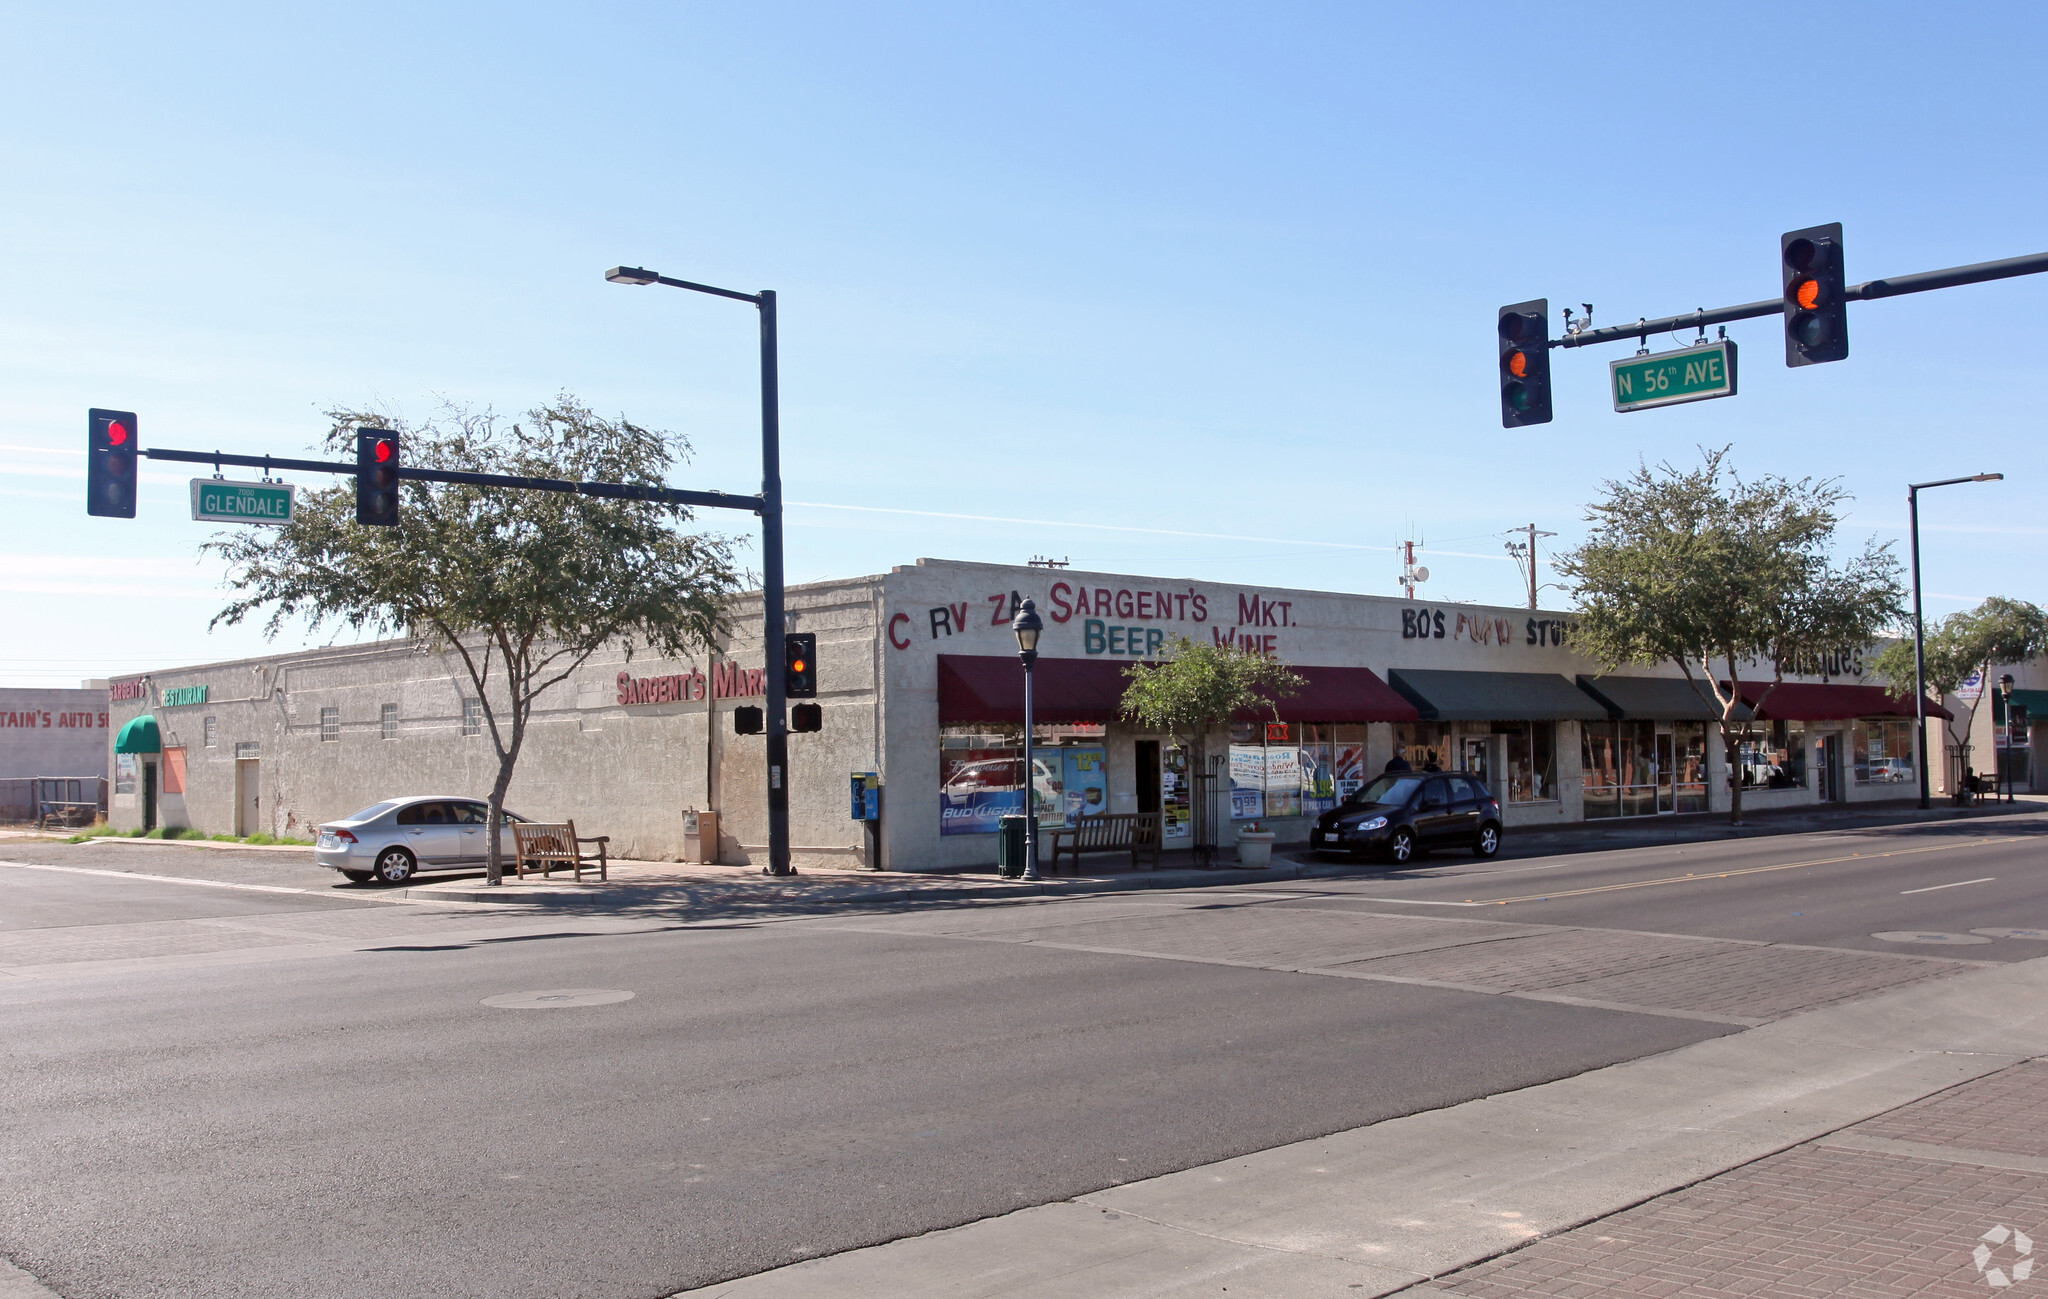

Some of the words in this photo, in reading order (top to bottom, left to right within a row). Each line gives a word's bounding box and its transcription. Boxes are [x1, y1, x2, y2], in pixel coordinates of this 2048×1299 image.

[1618, 373, 1632, 396] N
[1644, 366, 1677, 392] 56th
[1684, 357, 1722, 386] AVE
[238, 488, 255, 497] 7000
[205, 494, 285, 516] GLENDALE
[1050, 582, 1208, 623] SARGENT'S
[1238, 593, 1297, 627] MKT.
[1085, 619, 1164, 656] BEER
[161, 685, 208, 708] RESTAURANT
[616, 667, 707, 705] SARGENT'S
[0, 709, 52, 729] TAIN'S
[58, 712, 93, 729] AUTO
[943, 808, 974, 819] BUD
[980, 806, 1021, 818] LIGHT
